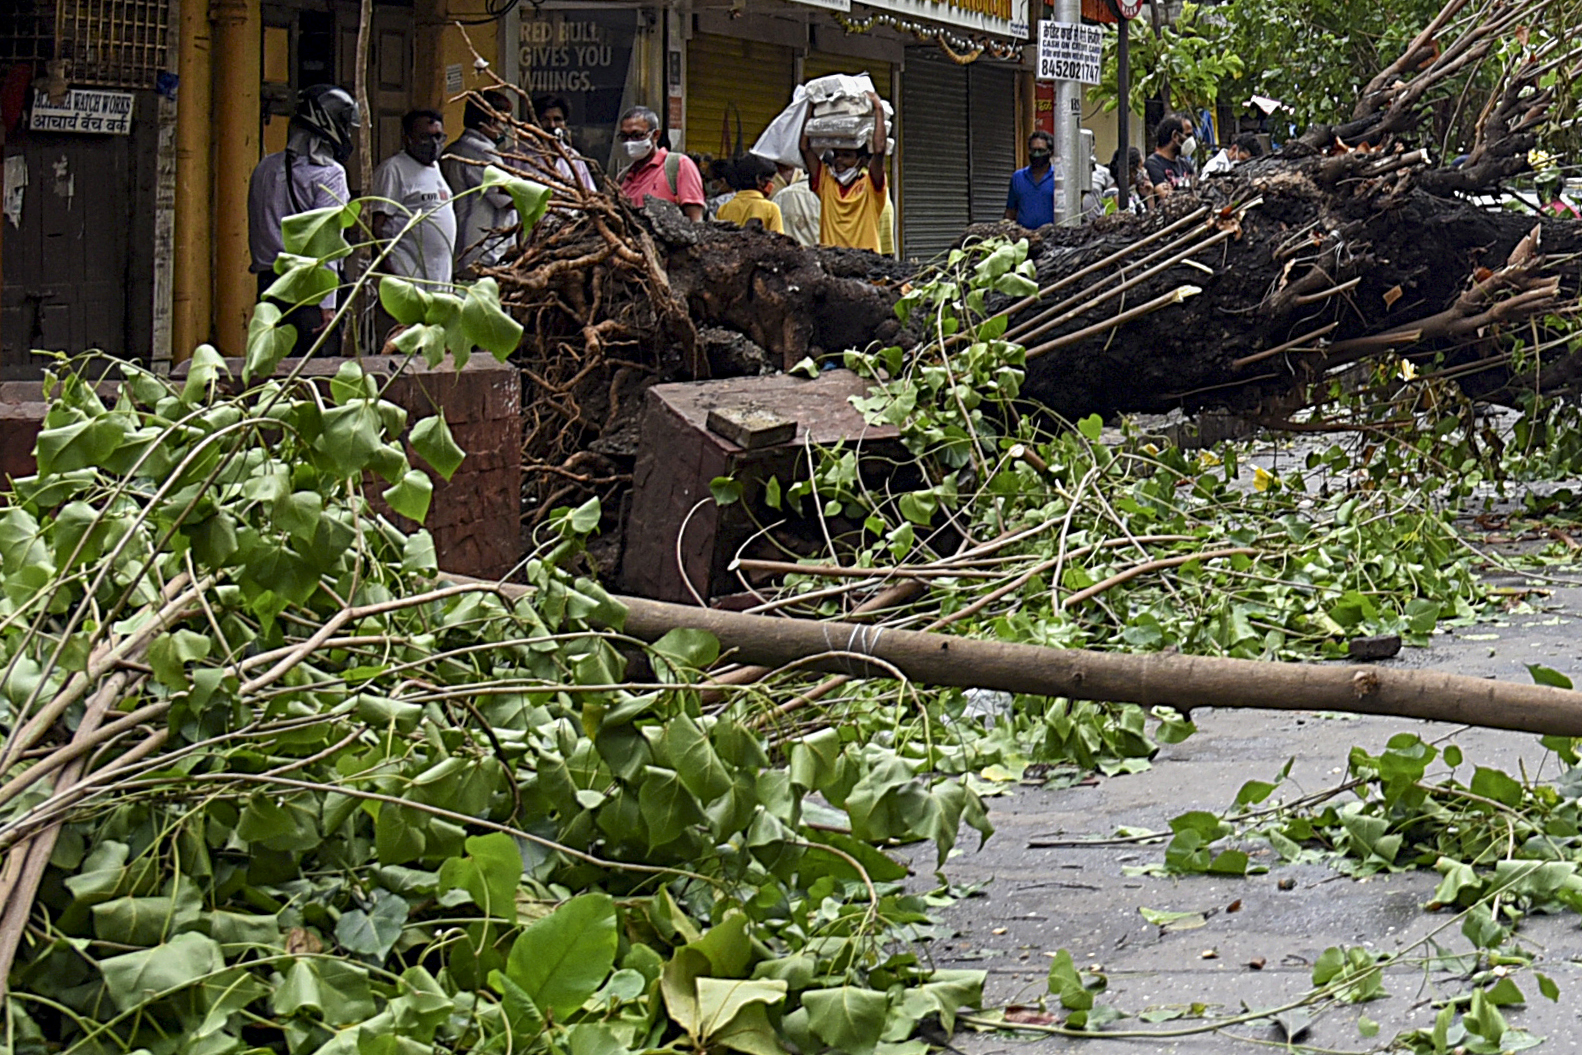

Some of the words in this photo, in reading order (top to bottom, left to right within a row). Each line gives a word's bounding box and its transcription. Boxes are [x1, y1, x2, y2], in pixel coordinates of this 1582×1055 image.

[519, 21, 553, 43] RED
[558, 21, 600, 43] BULL
[1042, 39, 1060, 49] CASH
[1061, 41, 1071, 50] ON
[519, 45, 570, 67] GIVES
[575, 45, 612, 67] YOU
[1041, 58, 1100, 83] 8452021747
[74, 92, 101, 113] WATCH
[102, 94, 131, 114] WORKS
[33, 112, 79, 129] आचार्य
[106, 114, 130, 132] वर्क
